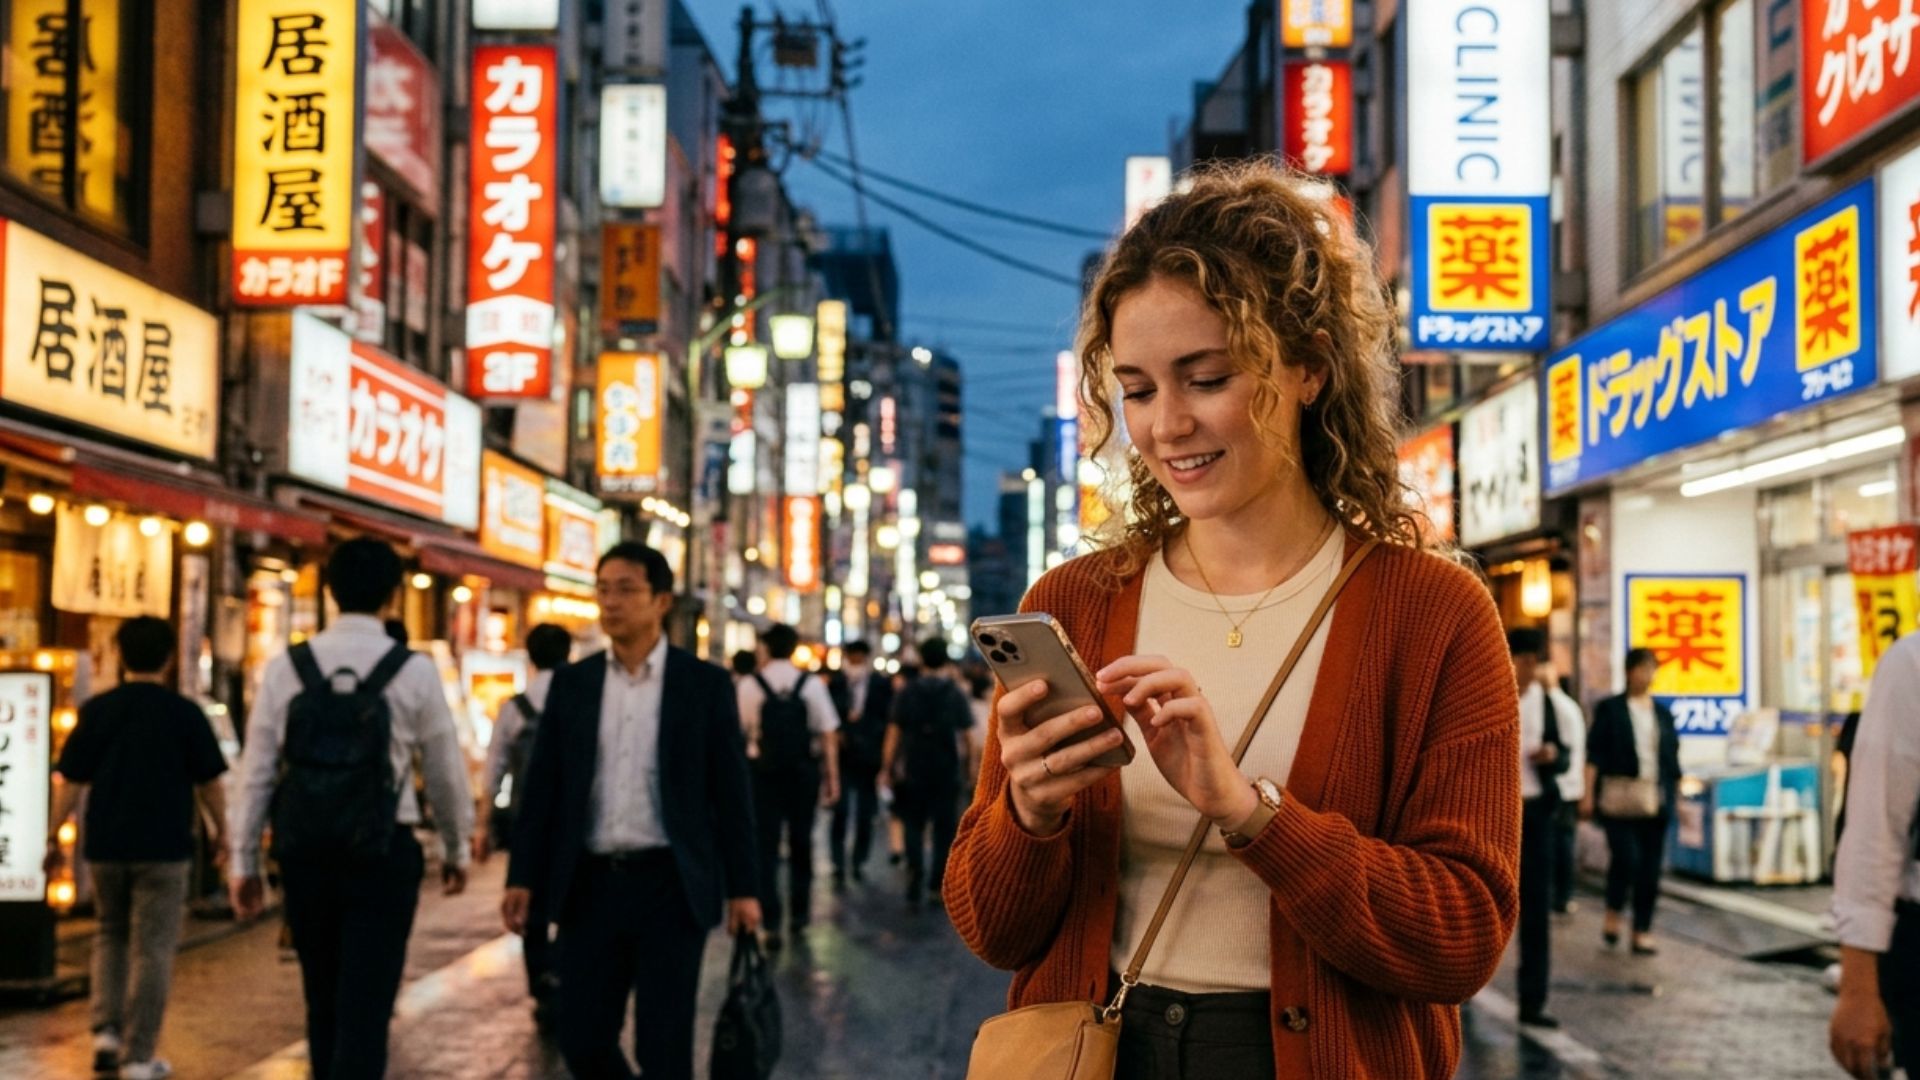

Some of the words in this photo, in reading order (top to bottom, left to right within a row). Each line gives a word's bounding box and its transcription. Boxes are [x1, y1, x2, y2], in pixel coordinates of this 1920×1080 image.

[259, 13, 329, 233] 居酒屋
[1455, 7, 1500, 181] CLINIC
[482, 55, 543, 292] カラオケ
[239, 256, 345, 298] カラオF
[1439, 215, 1520, 301] 薬
[1803, 225, 1850, 353] 薬
[29, 276, 174, 417] 居酒屋
[1417, 314, 1544, 343] ドラッグストア
[1587, 275, 1778, 447] ドラッグストア
[351, 378, 444, 483] カラオケ
[1645, 590, 1724, 672] 薬
